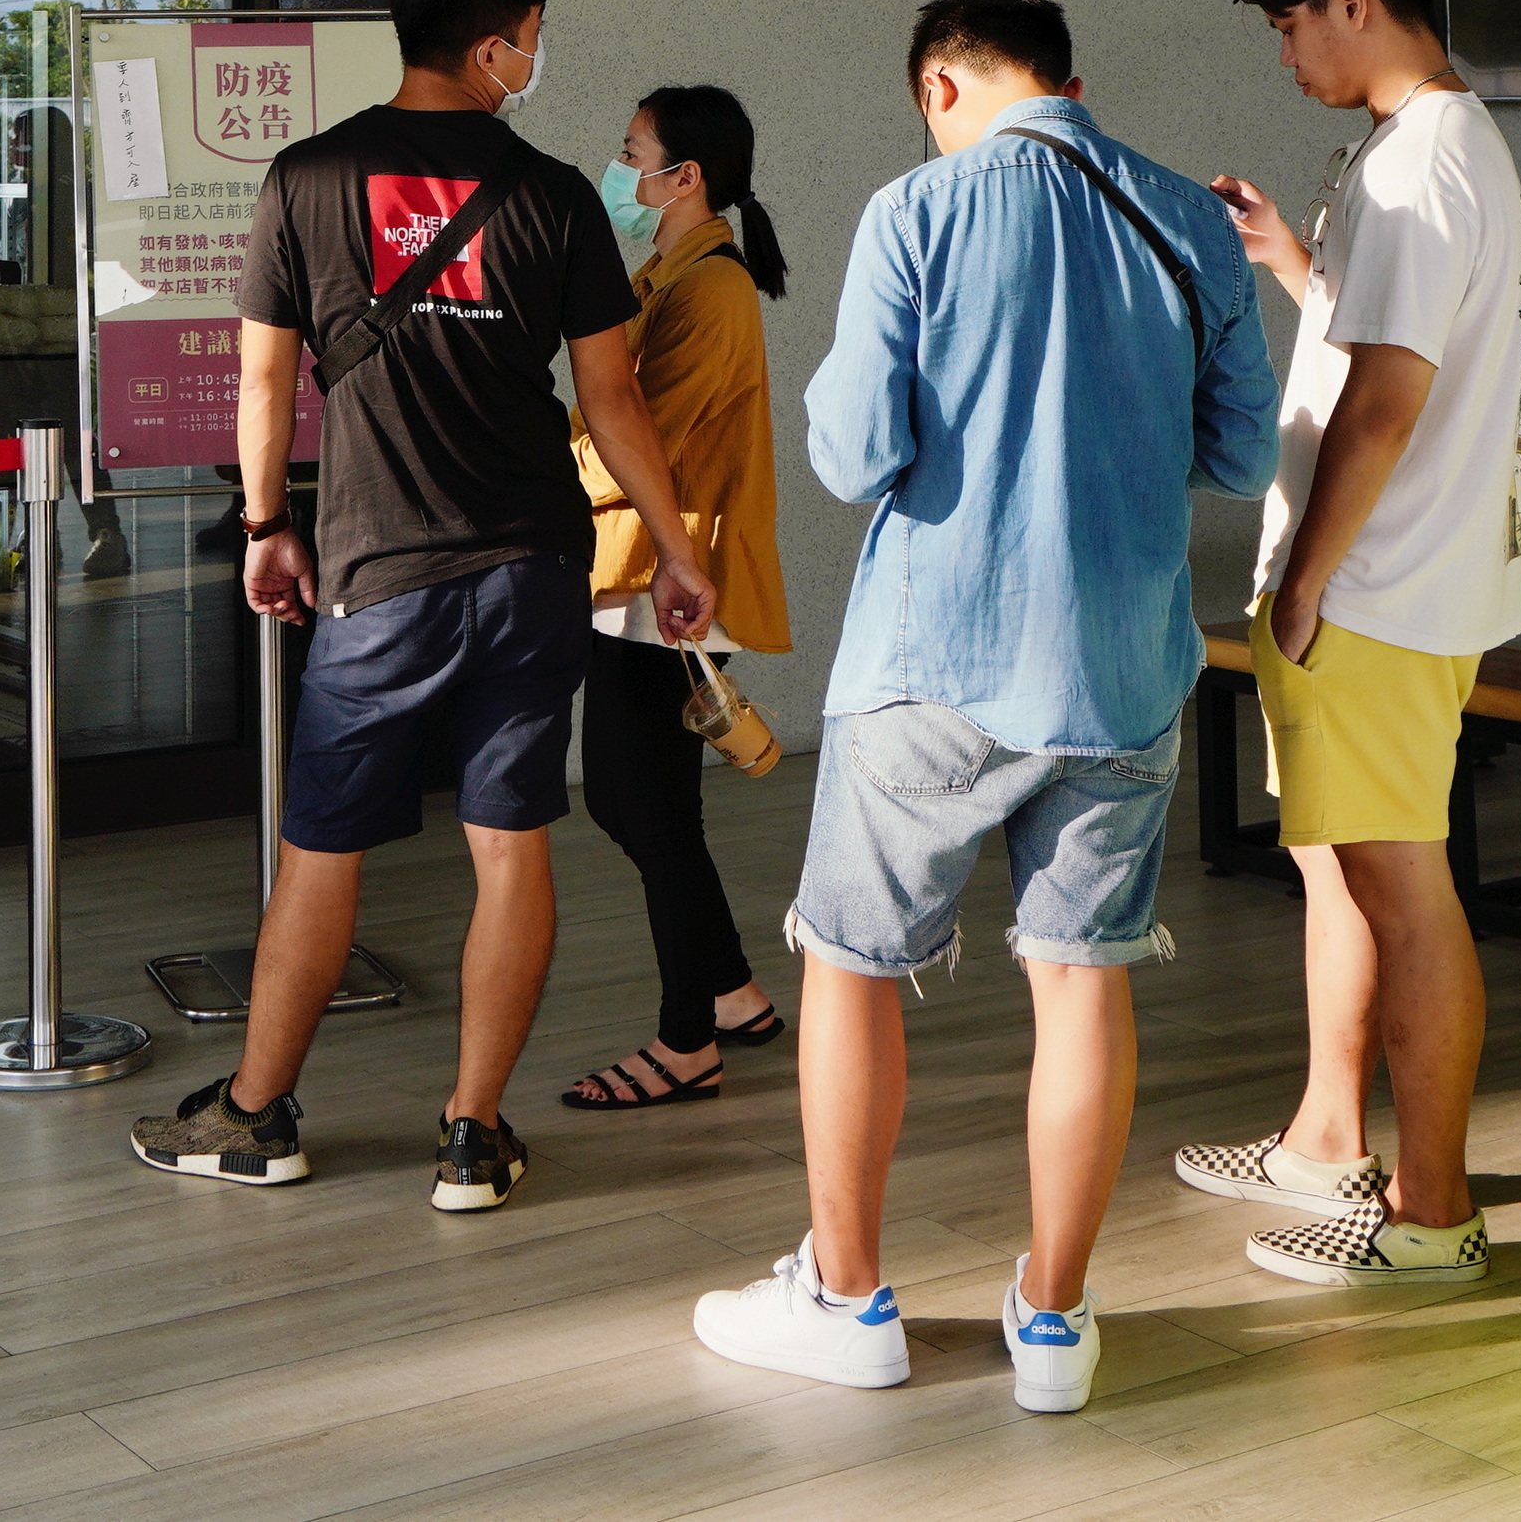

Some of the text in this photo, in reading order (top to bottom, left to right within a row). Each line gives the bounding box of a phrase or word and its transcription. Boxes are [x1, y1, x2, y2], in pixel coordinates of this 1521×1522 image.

[215, 61, 293, 98] 防疫
[216, 104, 293, 141] 公告
[167, 181, 264, 200] 合政府管制
[139, 203, 256, 222] 即日起入店前須
[409, 212, 440, 231] THE
[384, 227, 440, 243] NORTH
[401, 242, 430, 257] FAC
[140, 255, 244, 274] 其他類似病徵
[196, 374, 240, 386] 10:45
[135, 383, 162, 397] 平日
[197, 390, 240, 402] 16:45
[1031, 1324, 1067, 1335] adidas
